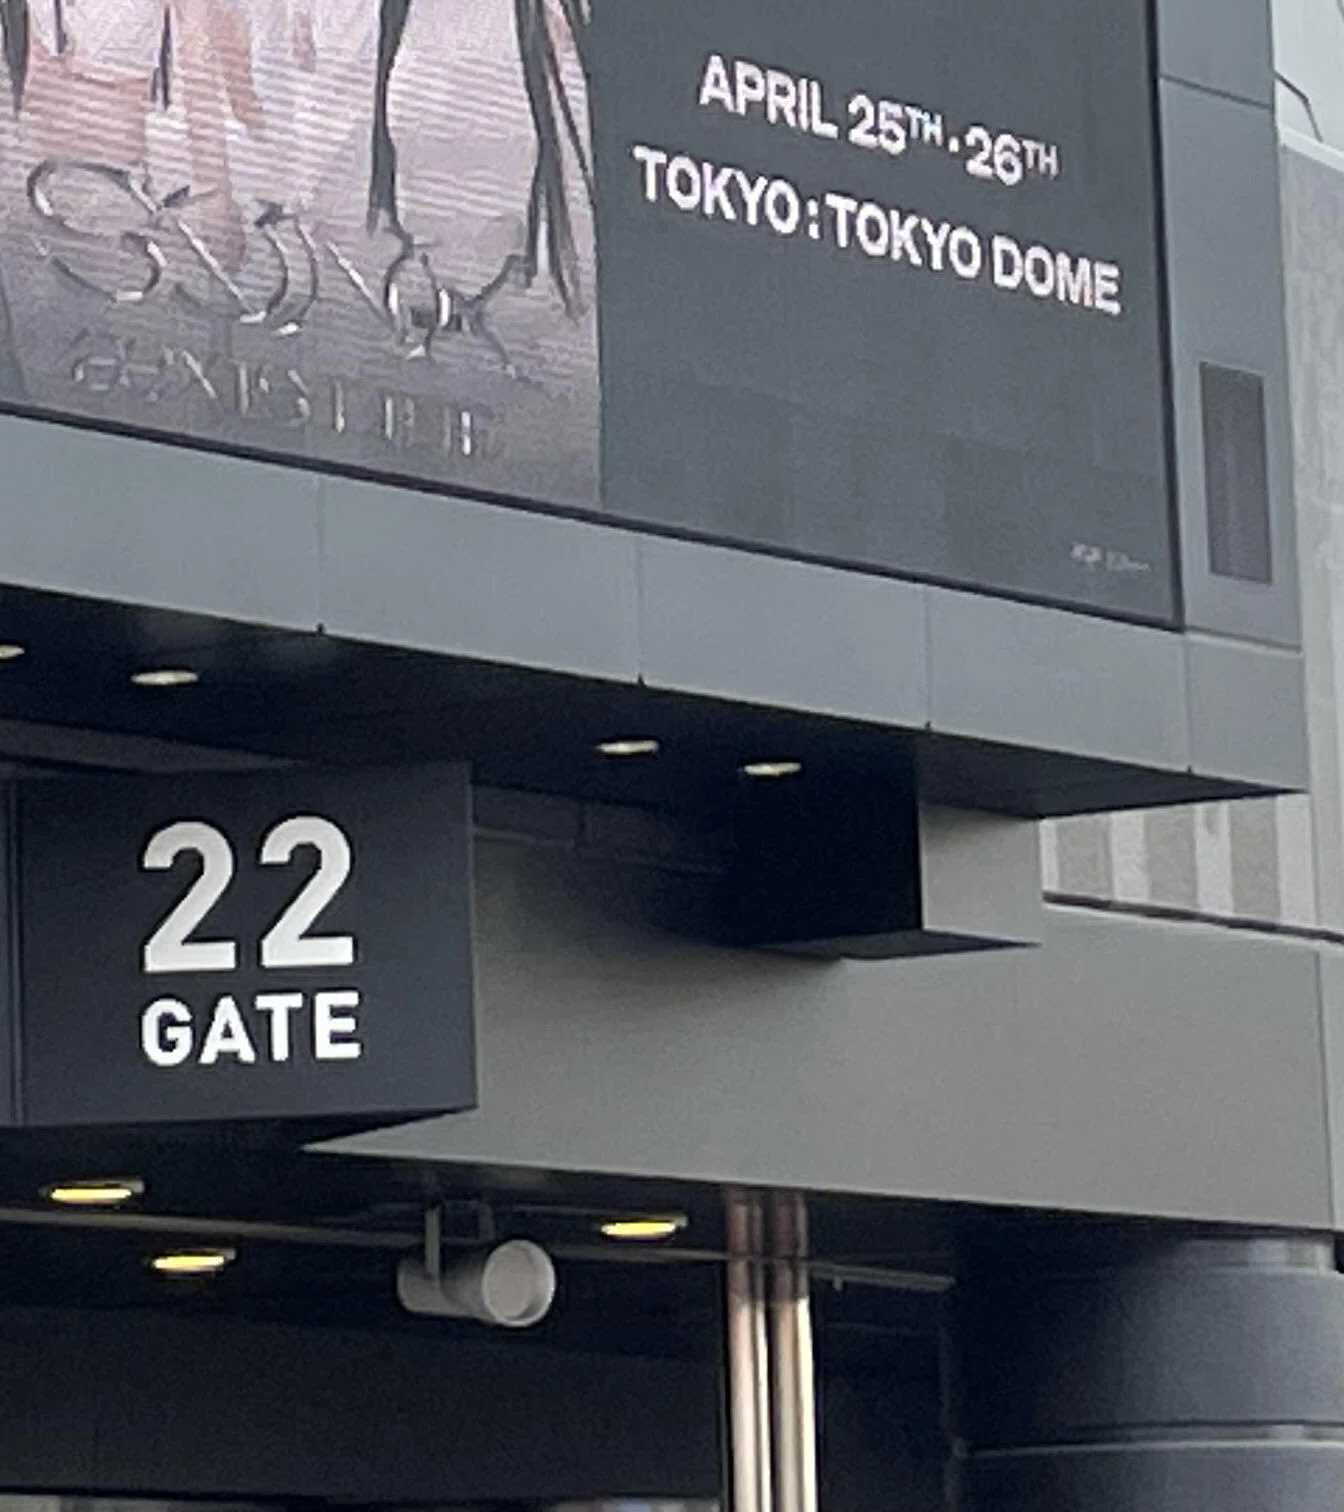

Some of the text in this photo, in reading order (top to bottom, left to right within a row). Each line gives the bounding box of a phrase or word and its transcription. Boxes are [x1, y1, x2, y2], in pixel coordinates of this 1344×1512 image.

[699, 53, 839, 139] APRIL
[632, 144, 802, 234] TOKYO
[824, 192, 983, 279] TOKYO
[992, 235, 1122, 316] DOME
[143, 816, 354, 973] 22
[140, 991, 362, 1067] GATE
